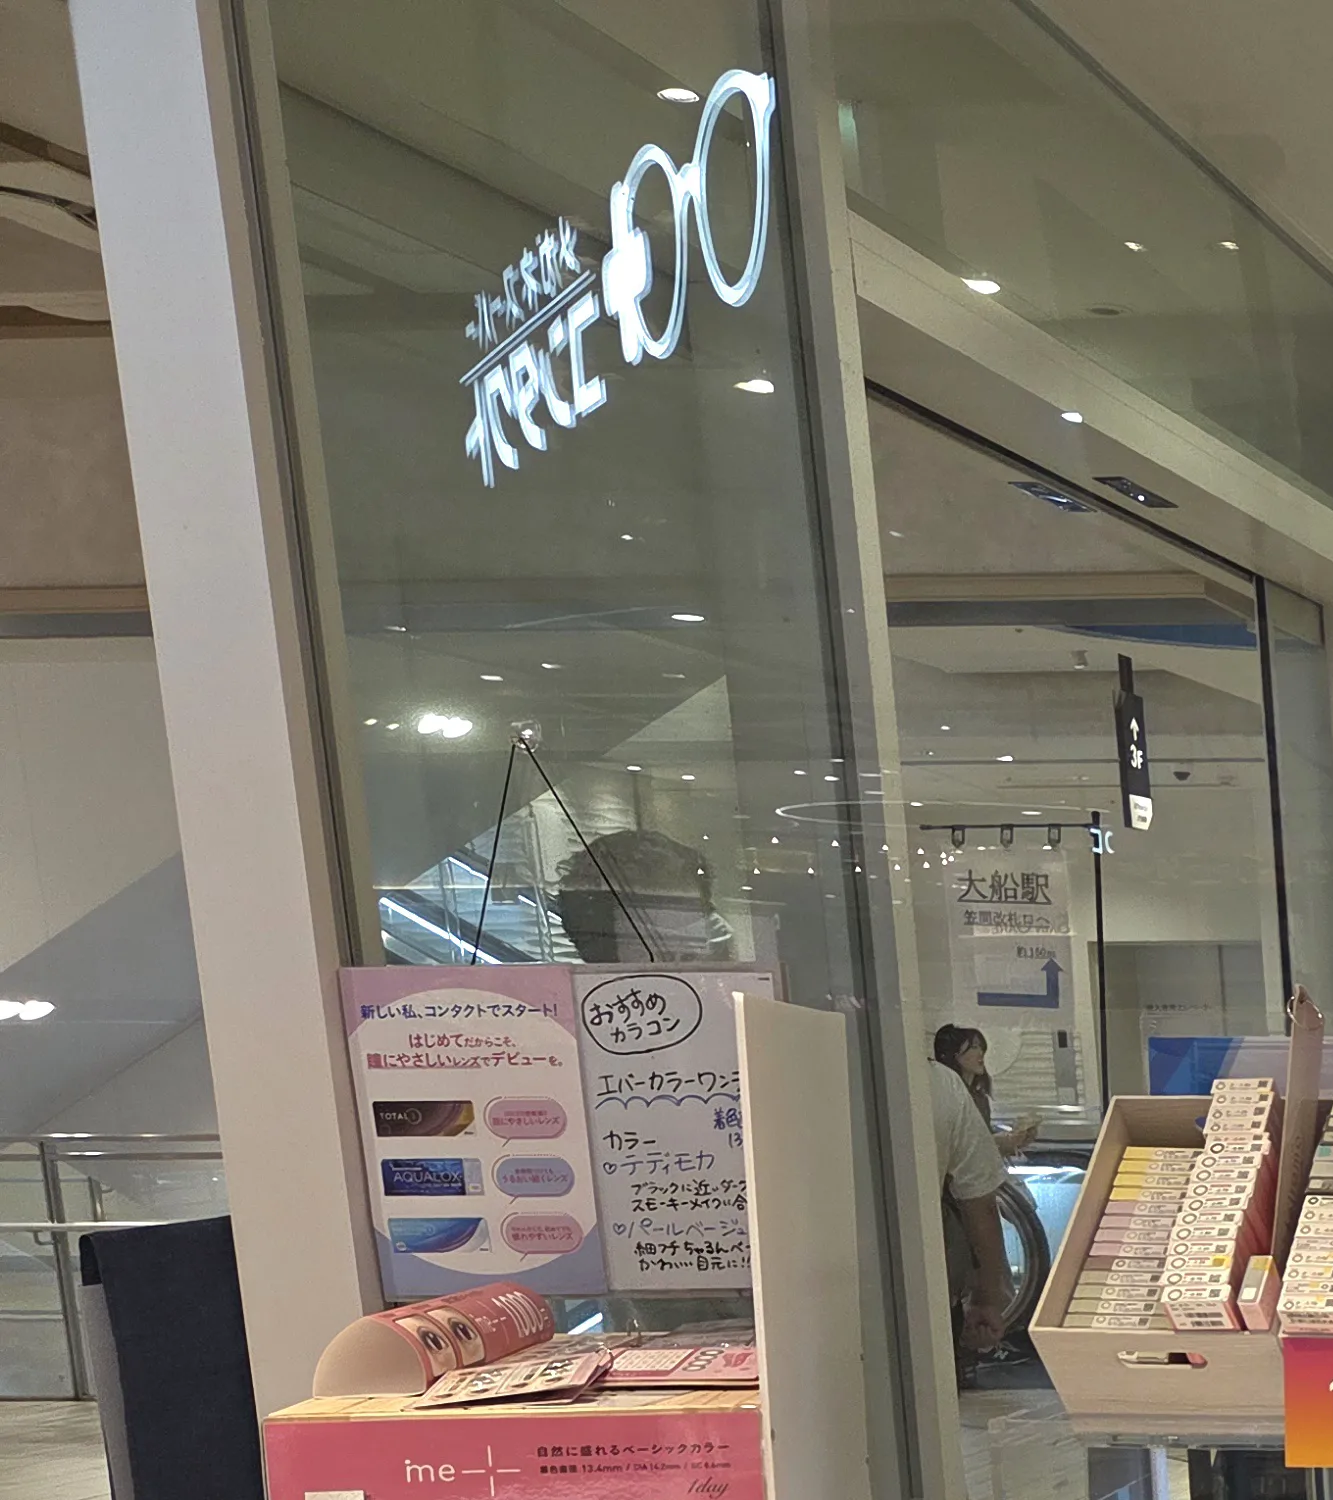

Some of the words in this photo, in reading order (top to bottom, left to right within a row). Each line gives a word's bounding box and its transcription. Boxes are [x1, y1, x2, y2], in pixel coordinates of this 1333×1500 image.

[1130, 744, 1143, 769] 3F
[958, 869, 1050, 902] 大船駅
[361, 1004, 557, 1019] 新しい私、コンタクトでスタート!
[589, 988, 666, 1026] おすすめ
[409, 1033, 517, 1048] はじめてだからこそ、
[611, 1017, 680, 1043] カラコン
[603, 1130, 656, 1150] カラー
[620, 1150, 714, 1175] テディモカ
[538, 1443, 730, 1457] 自然に盛れるベーシックカラー
